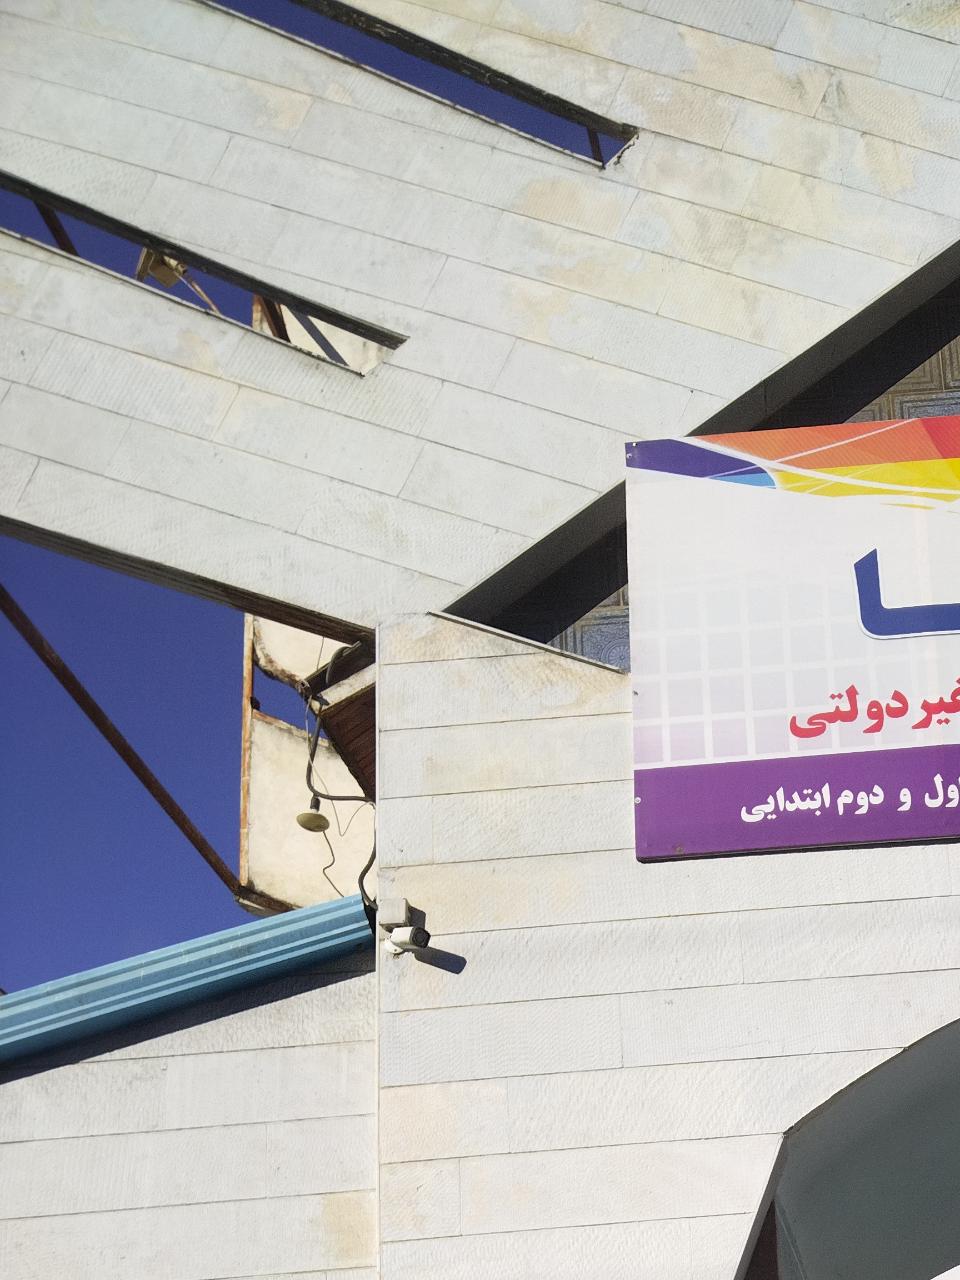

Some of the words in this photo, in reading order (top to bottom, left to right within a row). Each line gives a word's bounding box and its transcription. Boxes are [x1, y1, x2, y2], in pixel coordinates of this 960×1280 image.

[740, 783, 831, 823] ابتدایی
[837, 784, 885, 815] دوم
[897, 787, 912, 811] و
